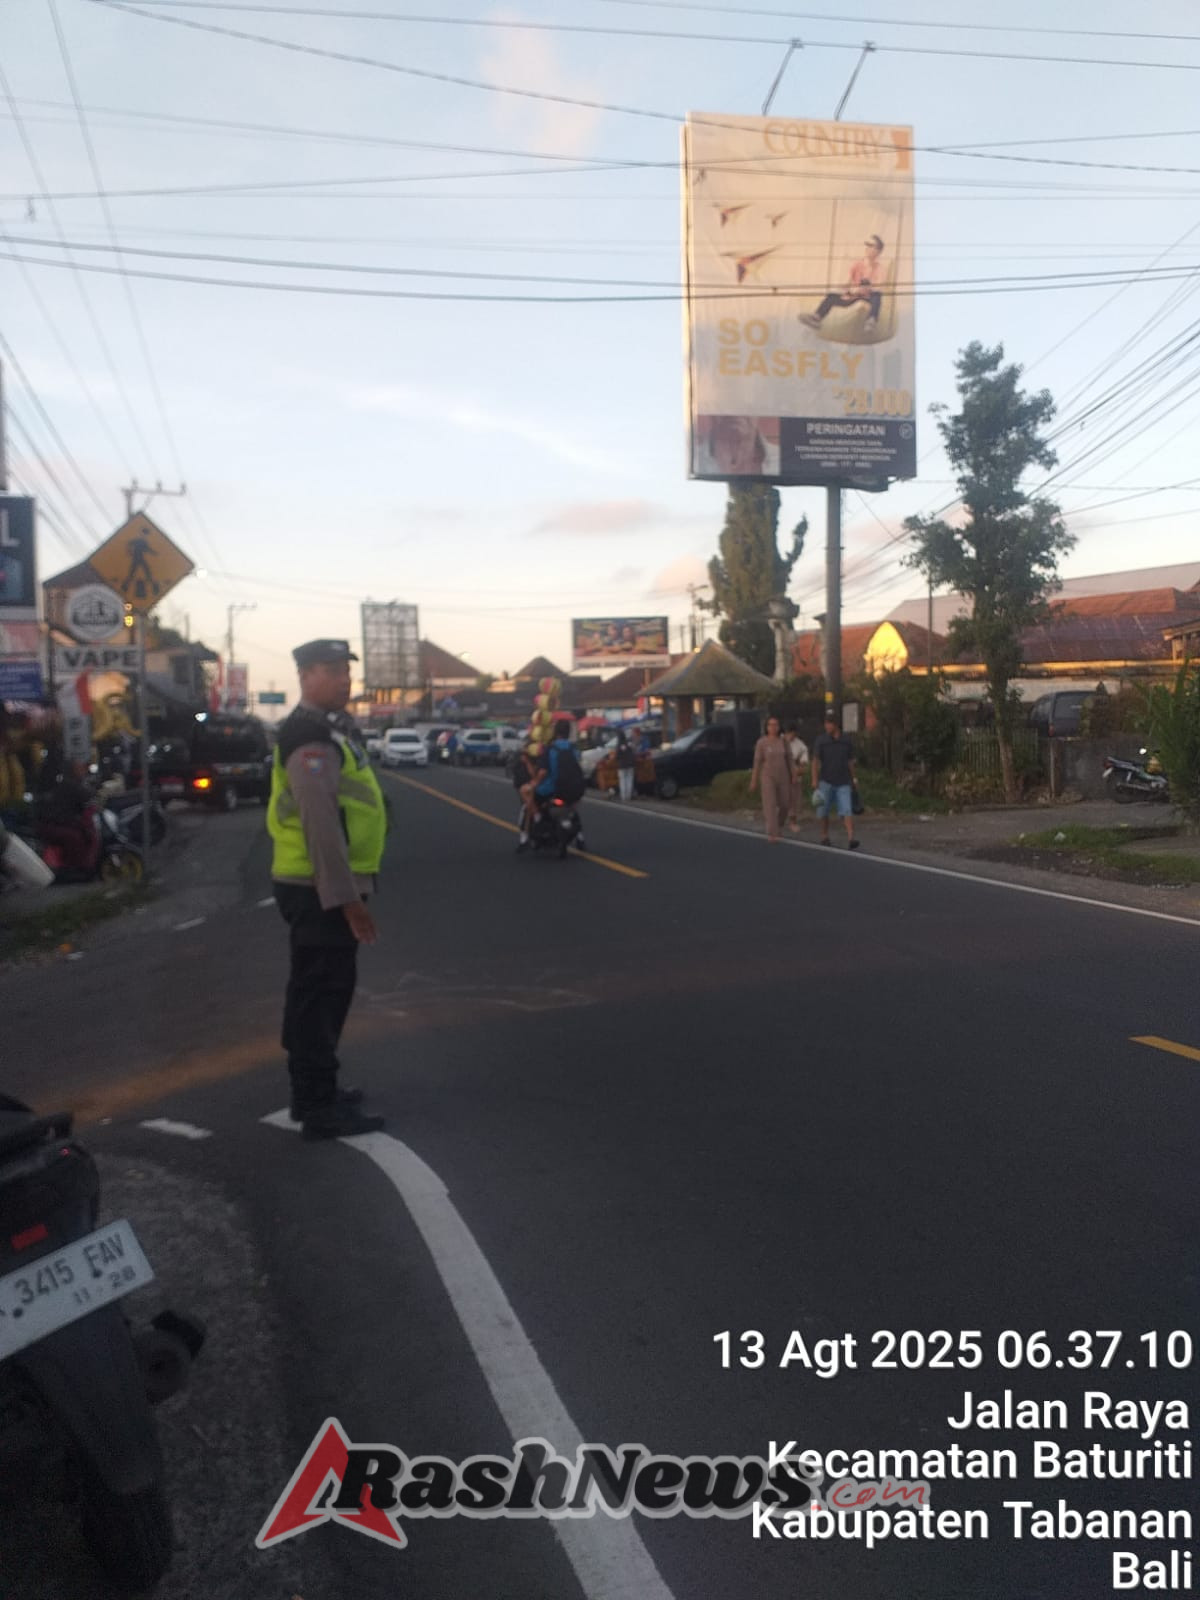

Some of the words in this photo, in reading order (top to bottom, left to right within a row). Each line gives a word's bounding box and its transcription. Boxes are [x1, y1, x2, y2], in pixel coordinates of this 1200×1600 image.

[717, 318, 770, 346] SO
[718, 348, 864, 379] EASFLY
[806, 423, 886, 436] PERINGATAN
[63, 649, 138, 668] VAPE
